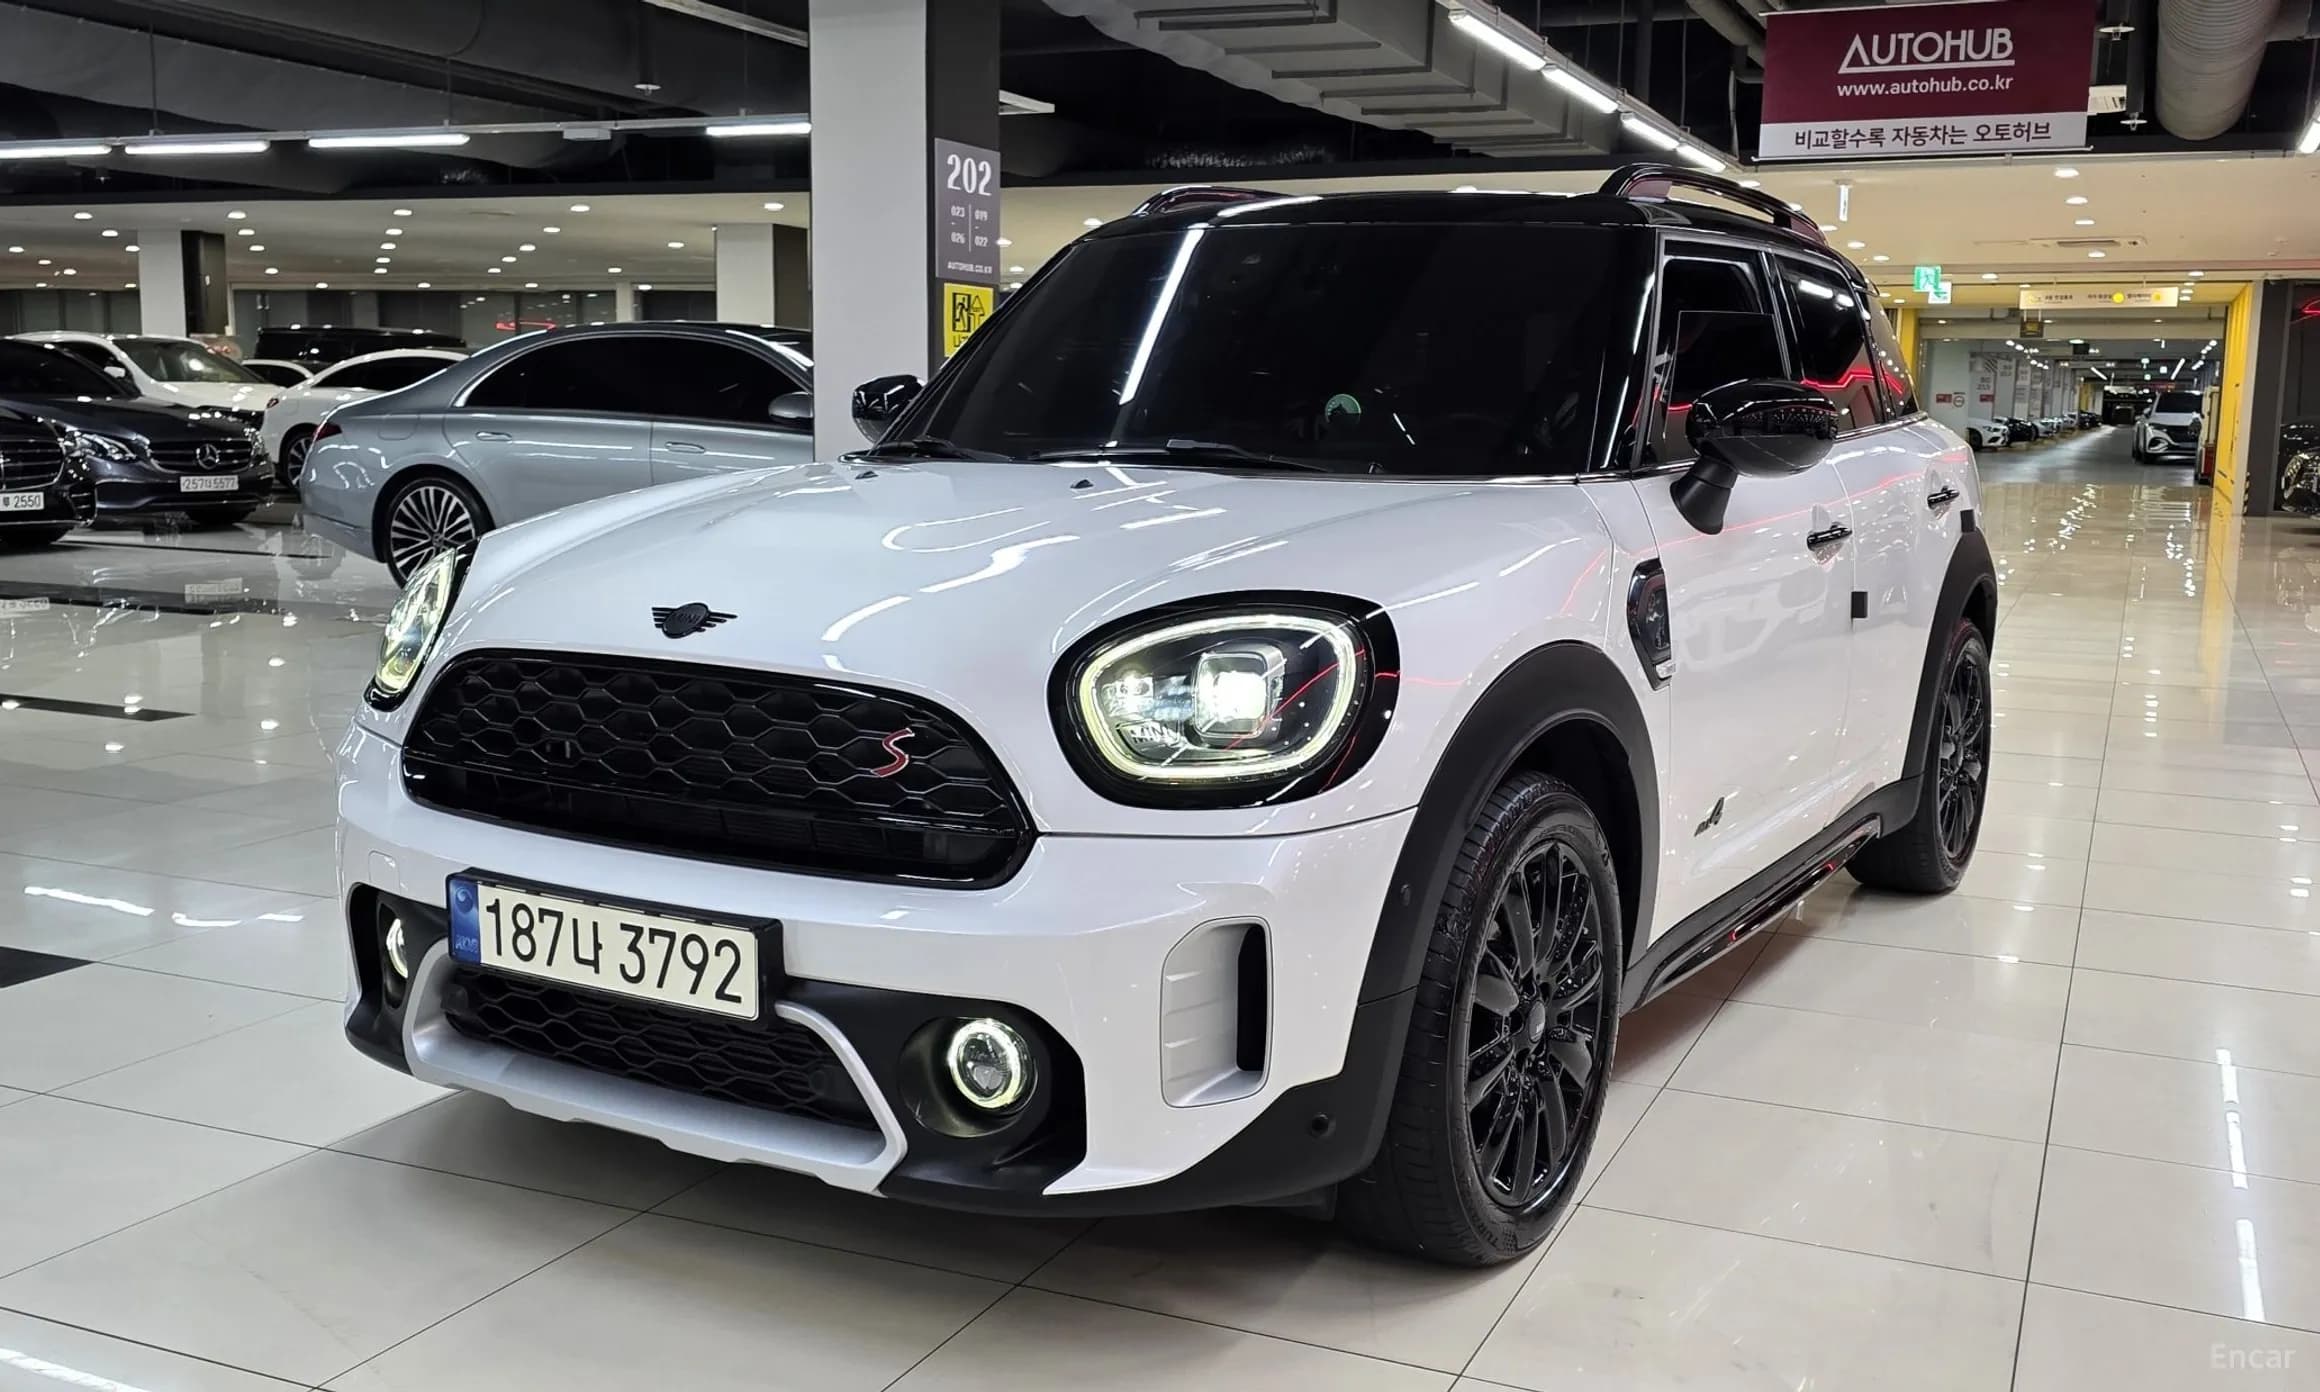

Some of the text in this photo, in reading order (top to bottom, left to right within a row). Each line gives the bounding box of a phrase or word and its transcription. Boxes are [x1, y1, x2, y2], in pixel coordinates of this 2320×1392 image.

[1838, 28, 2015, 74] AUTOHUB
[1837, 74, 2014, 97] www.autohub.co.kr
[1795, 120, 2052, 150] 비교할수록 자동차는 오토허브
[947, 153, 992, 197] 202
[13, 494, 42, 509] 2550
[871, 727, 915, 778] S
[486, 898, 742, 1004] 187나 3792
